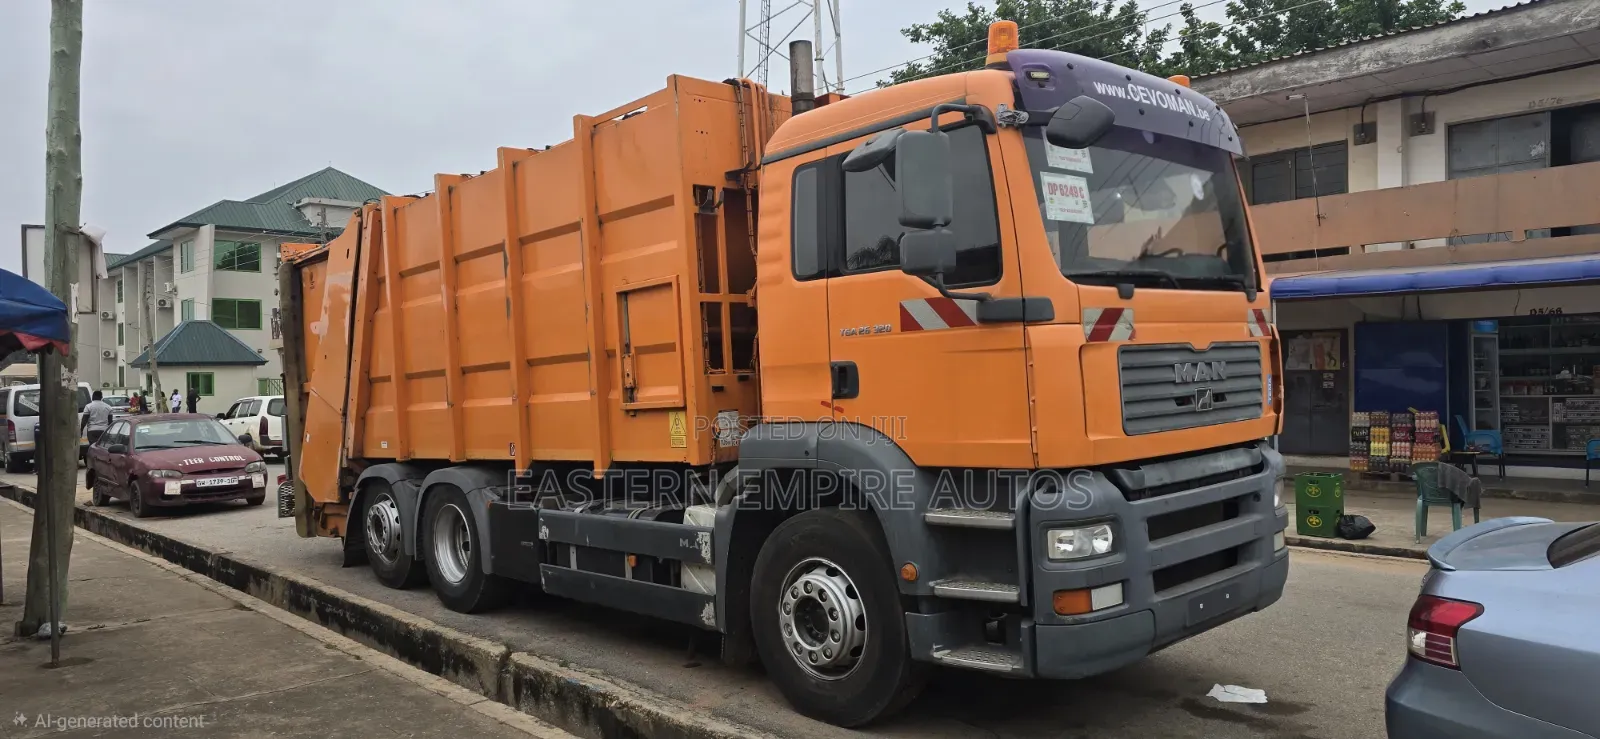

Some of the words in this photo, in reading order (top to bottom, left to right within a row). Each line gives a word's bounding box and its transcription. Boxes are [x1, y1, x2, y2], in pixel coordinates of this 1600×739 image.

[1093, 81, 1210, 121] www.CEVOMAN.be
[1047, 182, 1058, 195] DP
[1174, 361, 1227, 383] MAN
[208, 455, 246, 463] CONTROL
